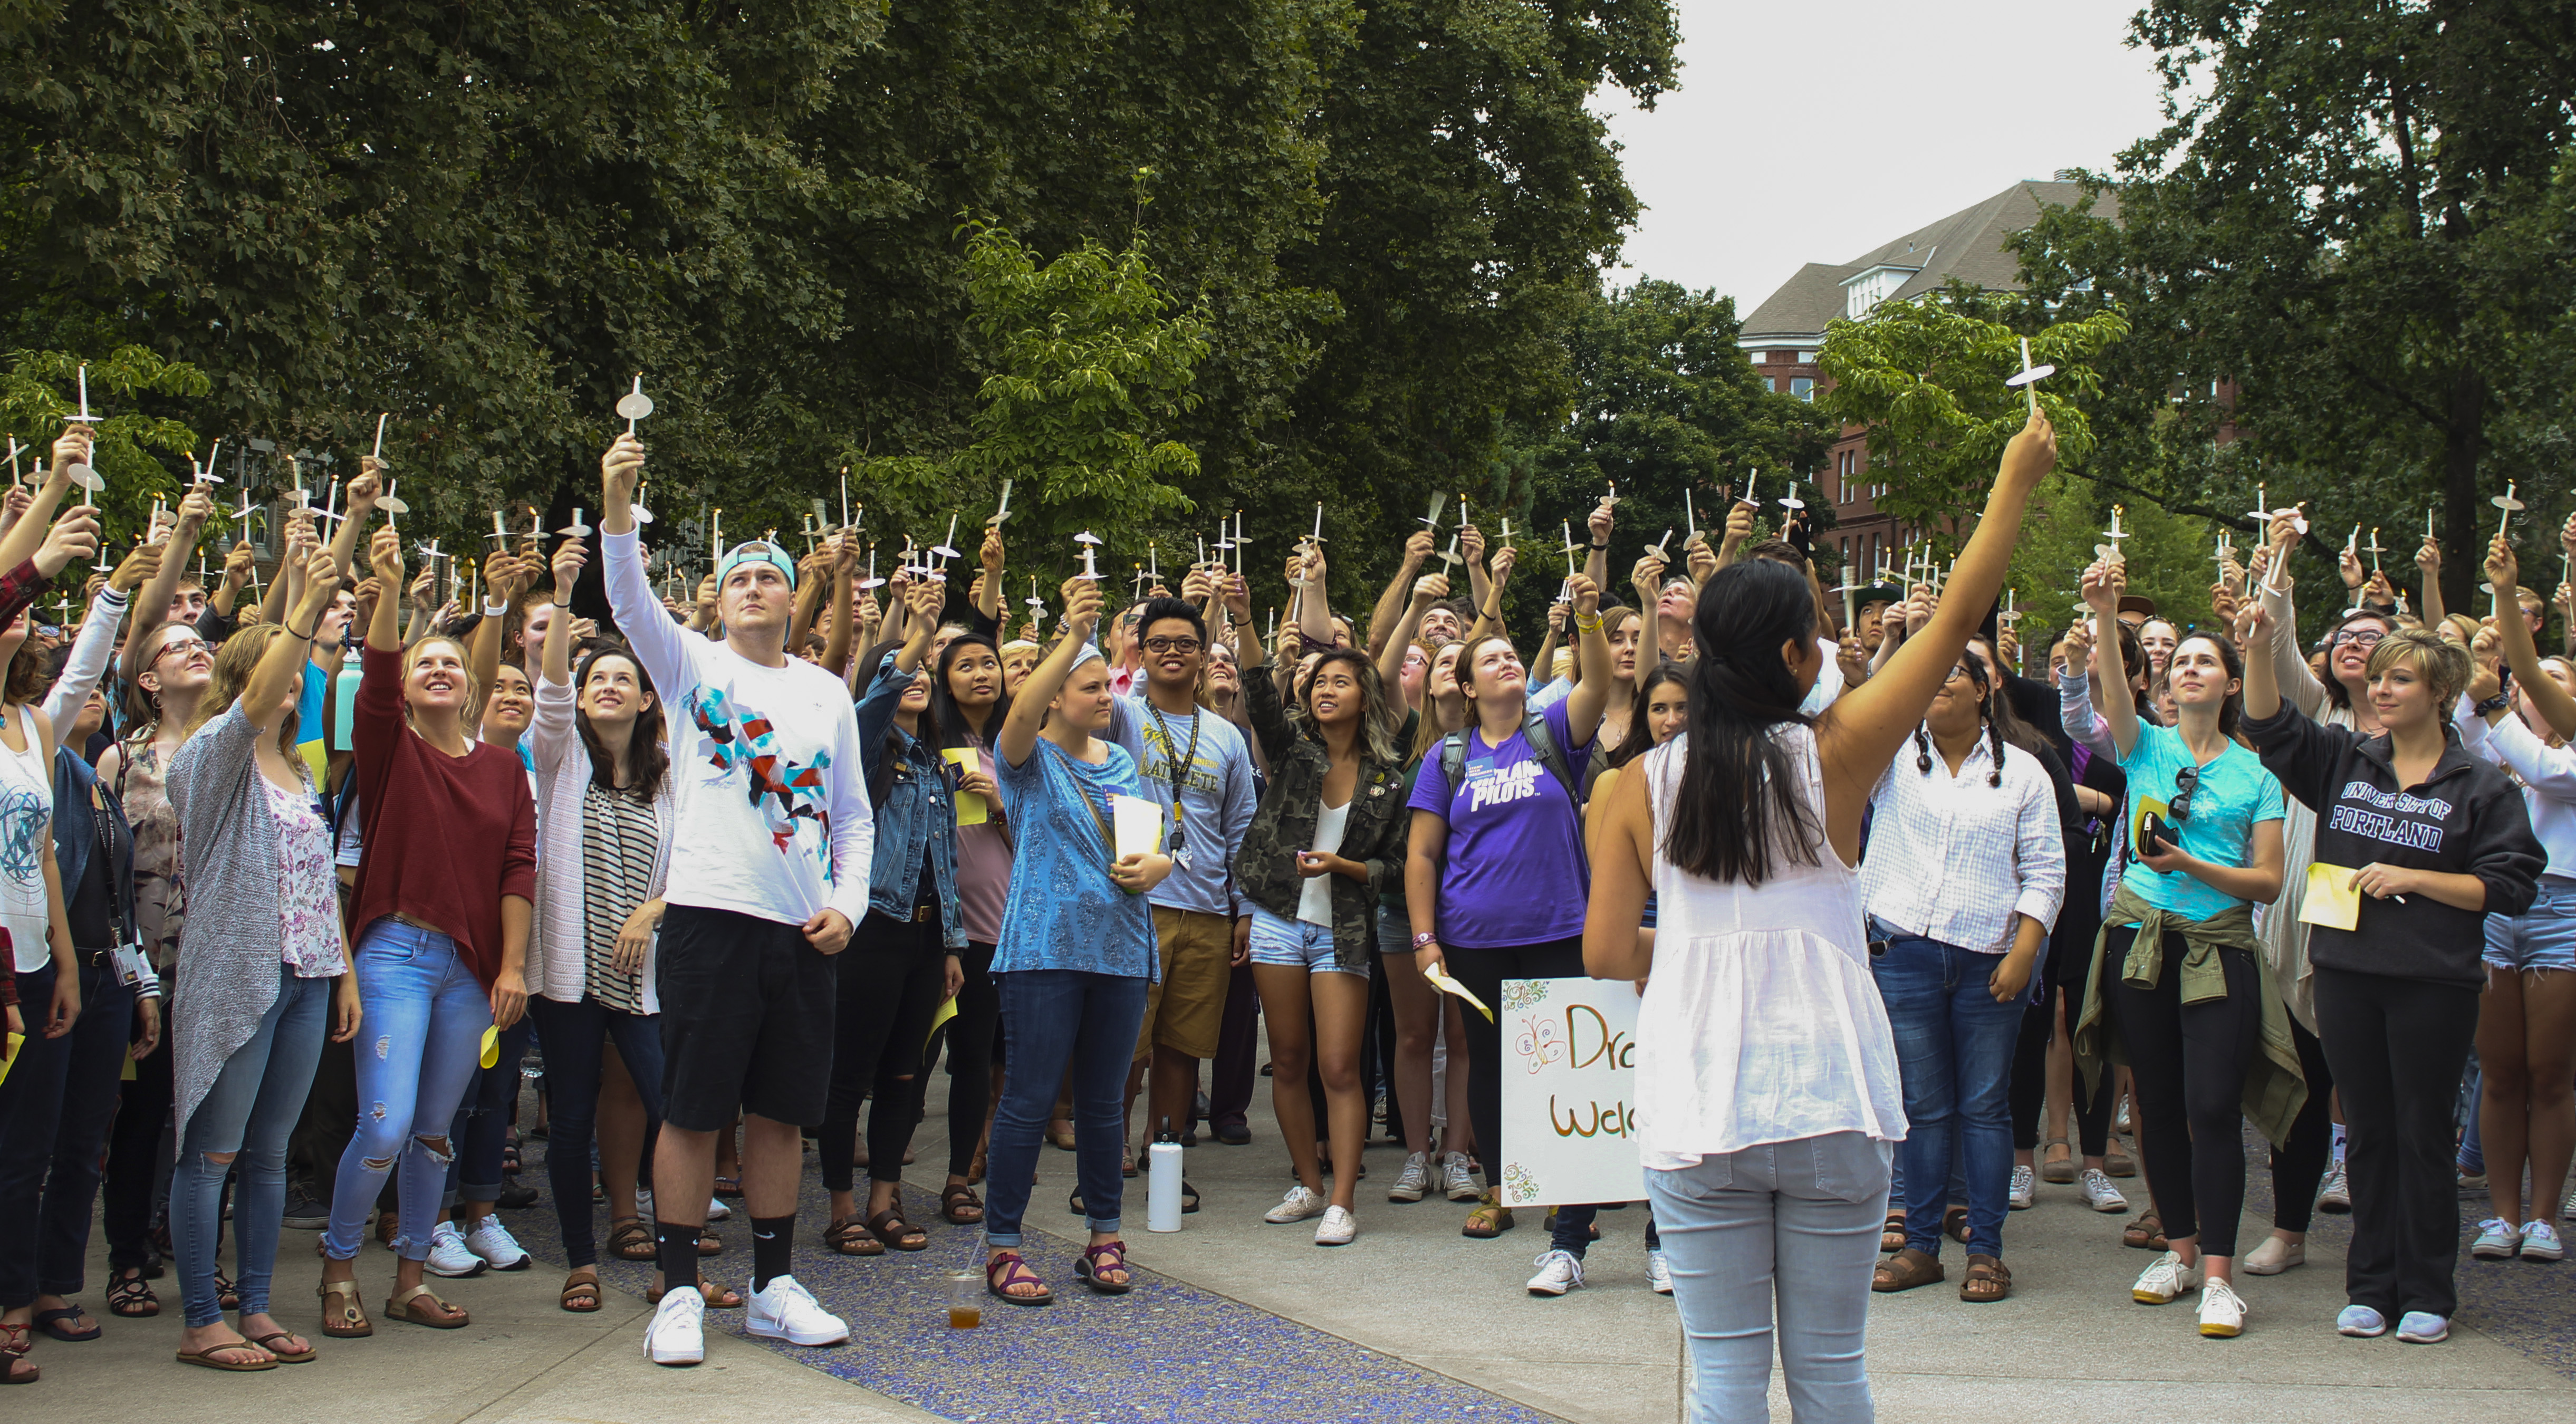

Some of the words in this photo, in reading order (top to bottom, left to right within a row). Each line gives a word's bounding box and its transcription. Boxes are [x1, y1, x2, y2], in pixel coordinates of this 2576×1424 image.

[1149, 758, 1219, 793] ATLETE
[1471, 777, 1534, 813] PILOTS
[2341, 781, 2432, 814] UNIVERSITY
[2429, 798, 2452, 821] OF
[2329, 804, 2443, 853] PORTLAND
